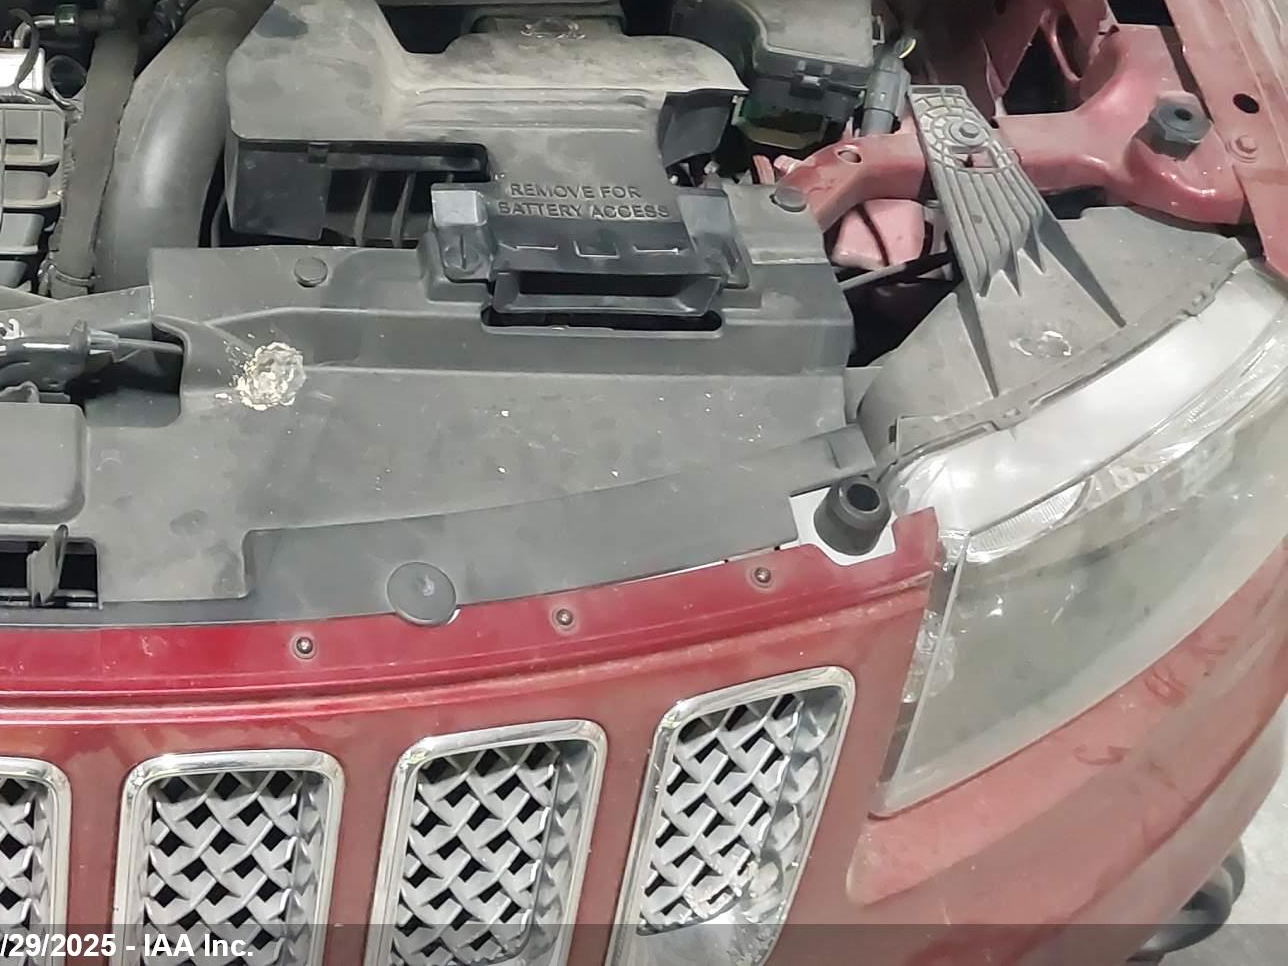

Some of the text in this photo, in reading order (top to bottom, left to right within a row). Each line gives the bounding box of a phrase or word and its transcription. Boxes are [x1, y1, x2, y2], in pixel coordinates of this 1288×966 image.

[510, 183, 642, 200] REMOVE FOR
[497, 200, 670, 219] BATTERY ACCESS
